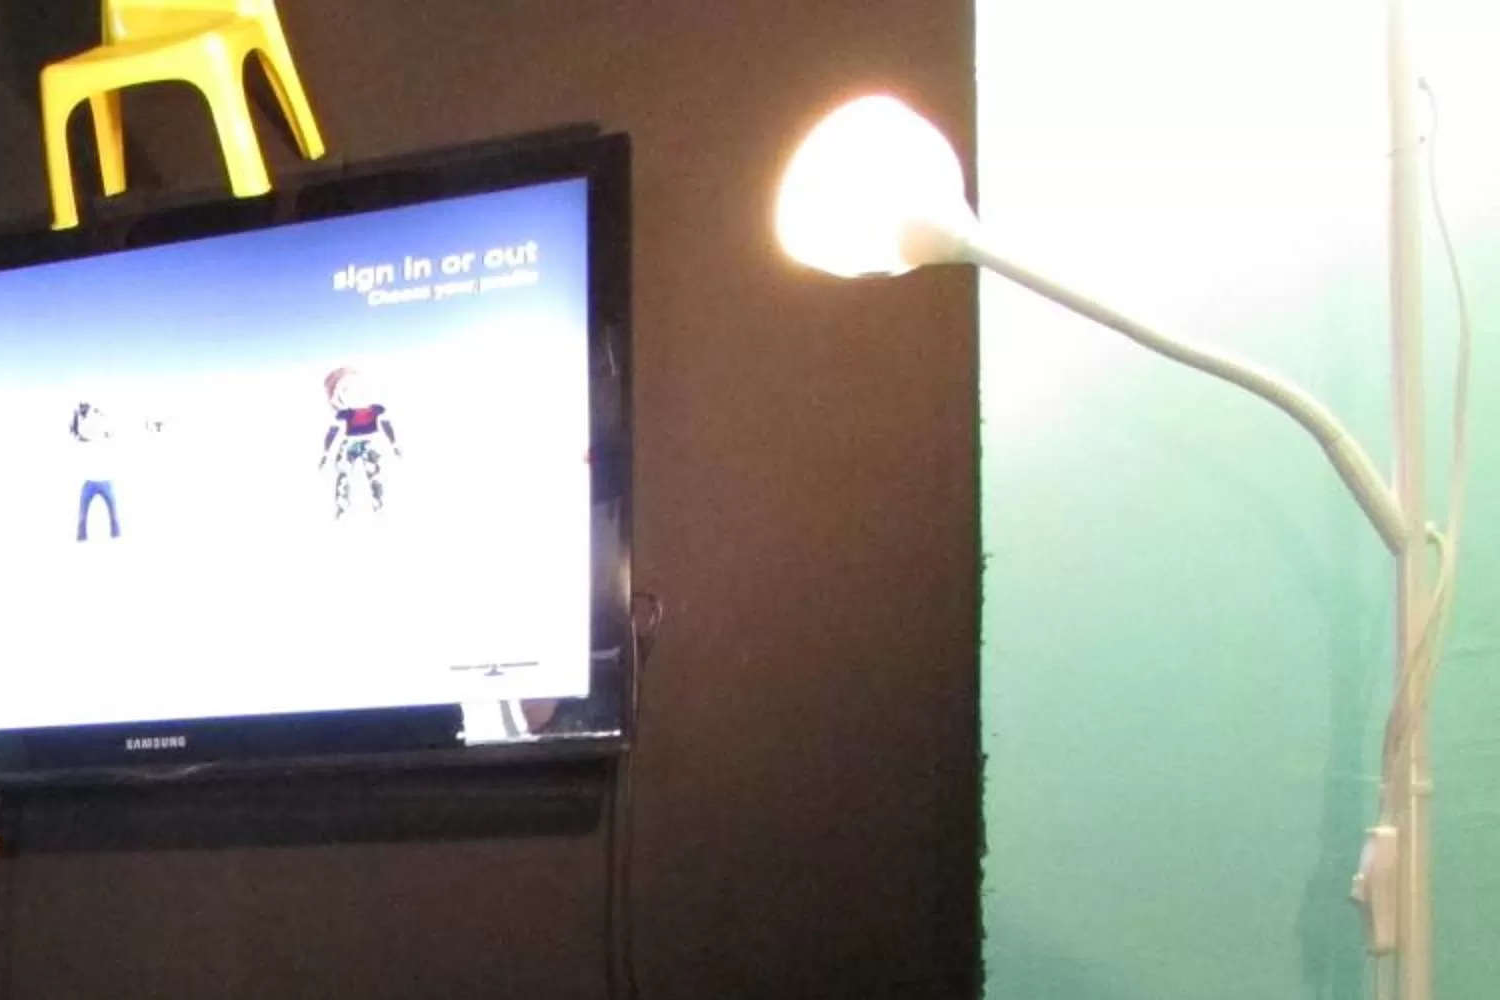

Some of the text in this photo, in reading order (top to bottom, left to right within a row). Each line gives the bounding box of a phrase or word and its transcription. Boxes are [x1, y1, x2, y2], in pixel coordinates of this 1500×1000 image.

[333, 240, 538, 292] sign in or out
[125, 735, 186, 750] SAMSUNG
